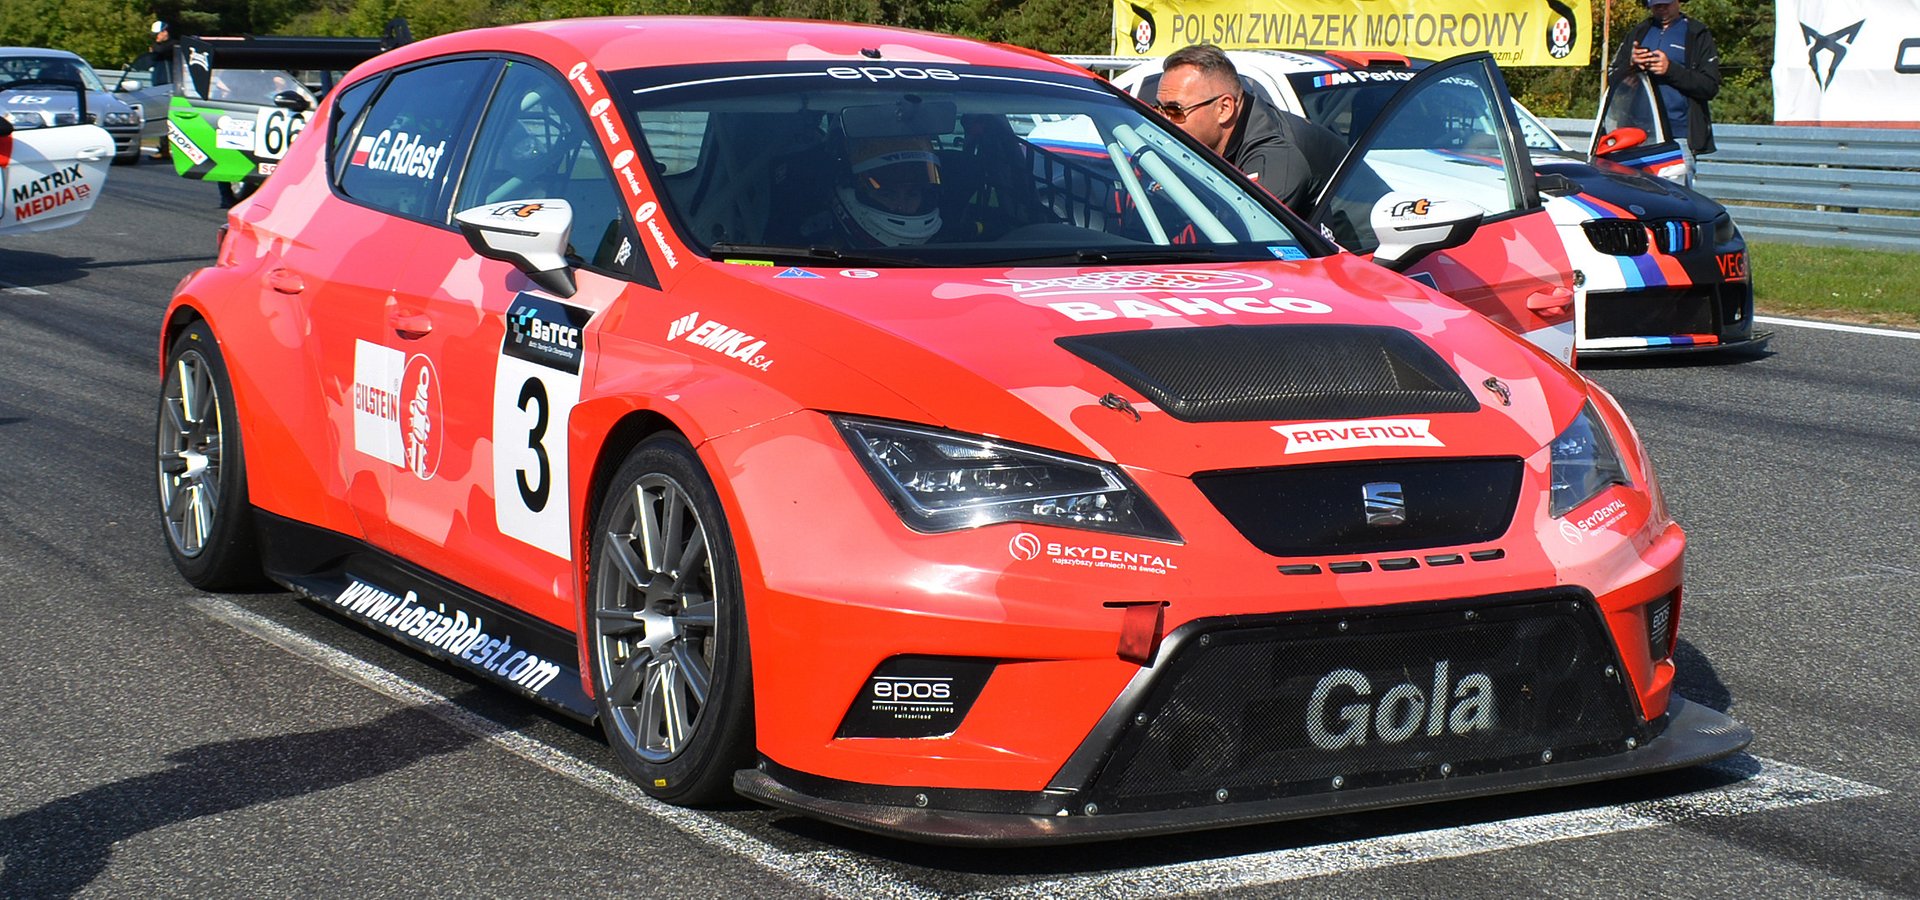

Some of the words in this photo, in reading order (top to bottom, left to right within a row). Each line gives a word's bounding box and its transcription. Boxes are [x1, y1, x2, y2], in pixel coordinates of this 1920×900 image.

[1171, 13, 1243, 45] POLSKI
[1246, 13, 1358, 49] ZWIĄZEK
[1365, 11, 1528, 47] MOTOROWY
[826, 66, 961, 82] epos
[368, 129, 447, 180] G.Rdest
[12, 163, 83, 204] MATRIX
[15, 187, 75, 221] MEDIA
[1047, 296, 1333, 322] BAHCO
[531, 317, 578, 350] BaTCC
[685, 320, 768, 363] EMKA
[356, 382, 398, 423] BILSTEIN
[515, 376, 551, 513] 3
[1291, 425, 1425, 444] RAVENOL
[1052, 556, 1093, 568] najszybszy
[1127, 564, 1137, 572] na
[334, 580, 560, 692] www.GosiaRdest.com
[873, 681, 951, 702] epos
[1306, 659, 1497, 750] Gola
